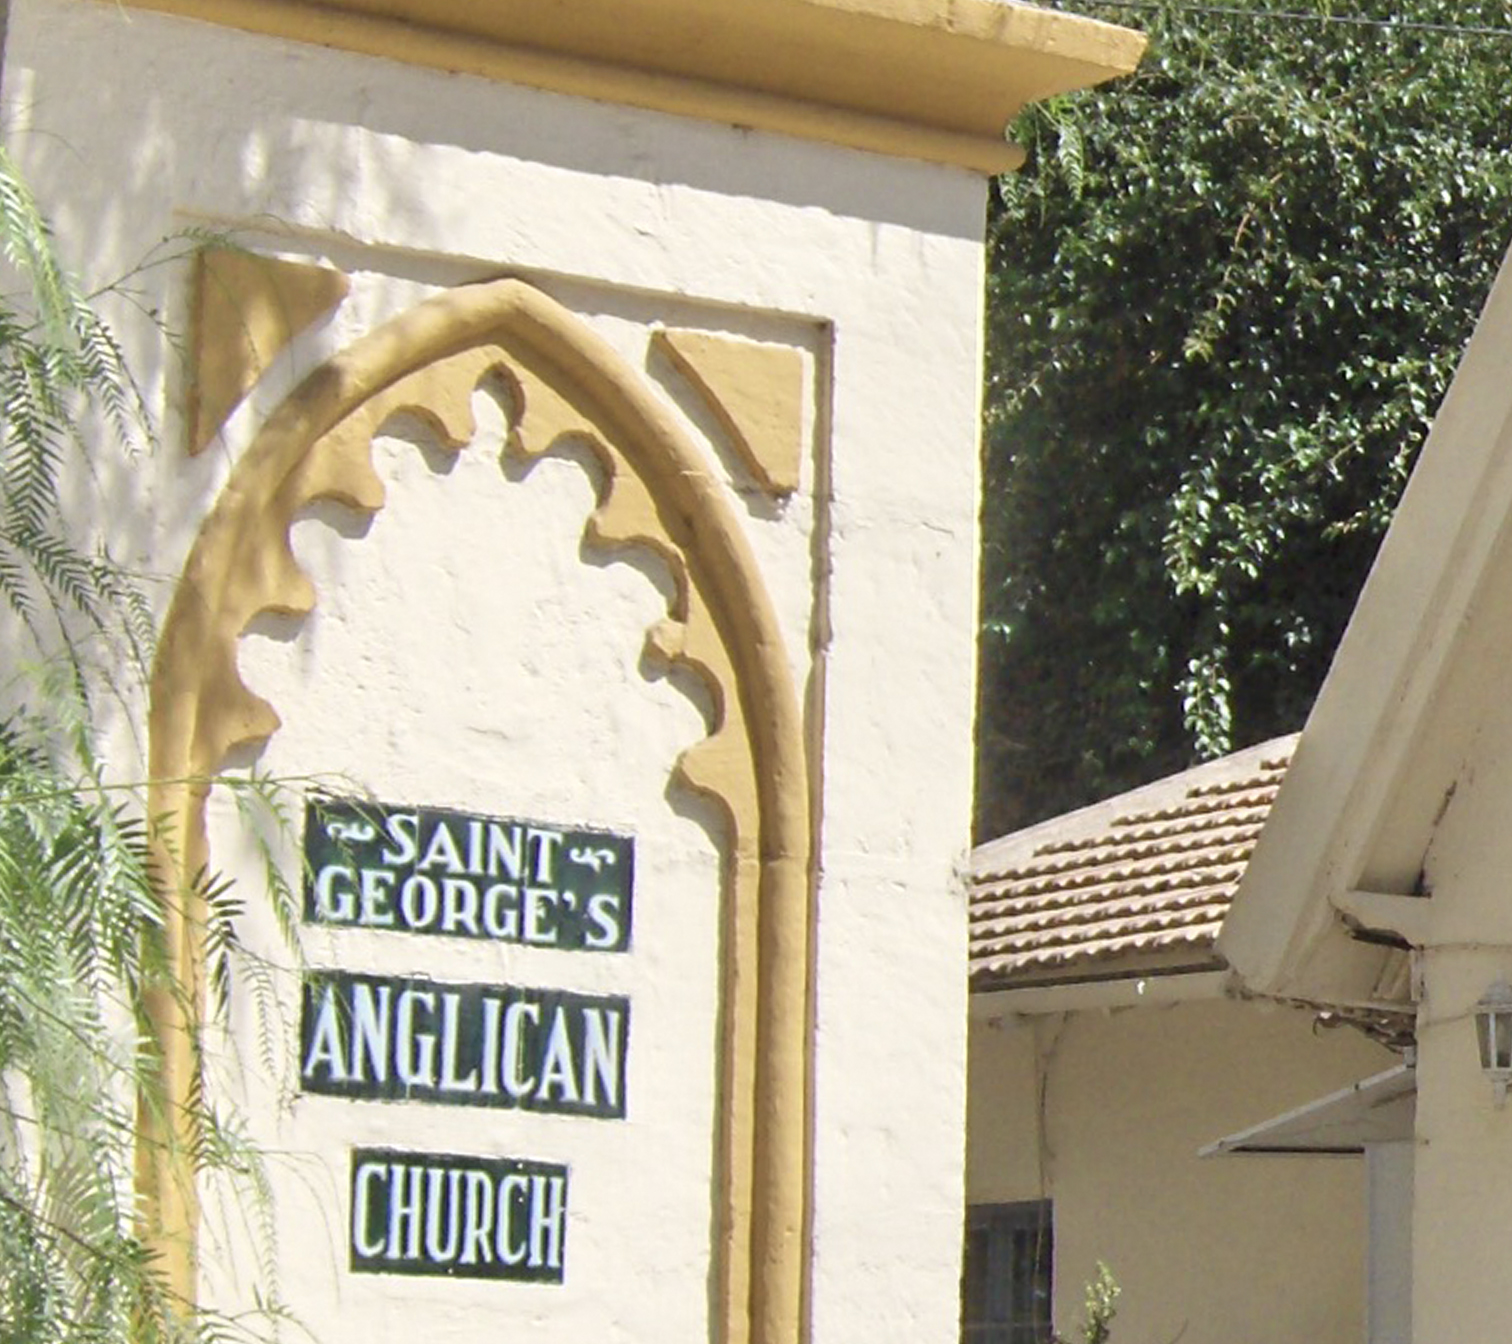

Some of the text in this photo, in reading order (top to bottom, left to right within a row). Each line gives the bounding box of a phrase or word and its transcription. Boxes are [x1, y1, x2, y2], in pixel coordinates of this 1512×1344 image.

[382, 813, 562, 884] SAINT
[316, 865, 620, 949] GEORGE'S
[302, 982, 620, 1107] ANGLICAN
[352, 1162, 564, 1268] CHURCH
